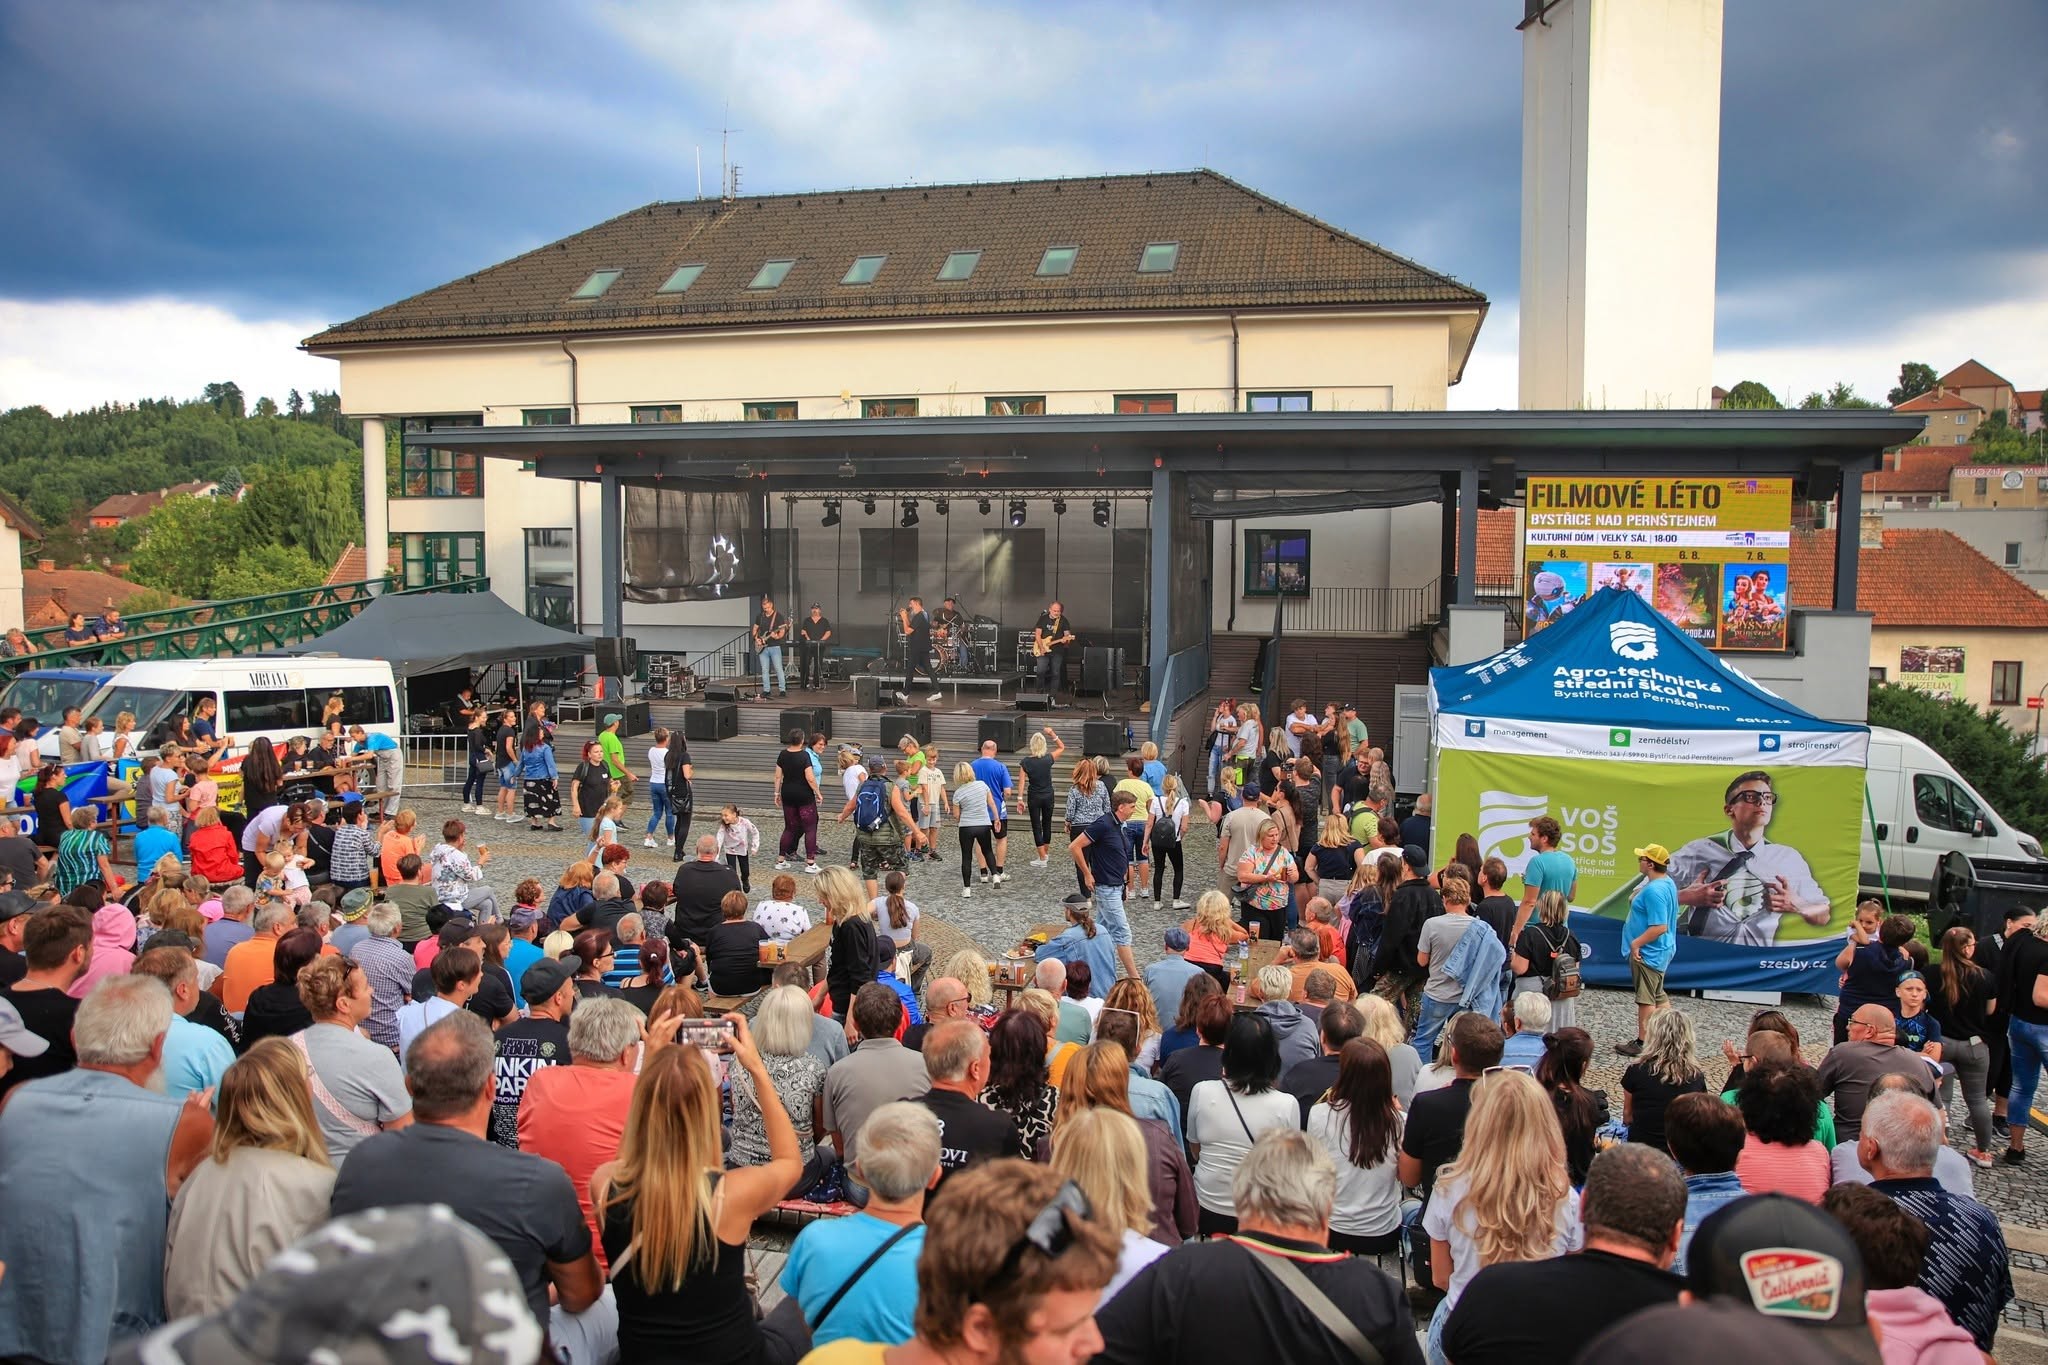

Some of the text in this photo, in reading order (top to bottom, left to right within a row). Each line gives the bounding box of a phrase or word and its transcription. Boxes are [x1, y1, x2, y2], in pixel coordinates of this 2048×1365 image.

[1531, 480, 1720, 509] FILMOVÉ LÉTO
[1531, 512, 1717, 527] BYSTŘICE NAD PERNŠTEJNEM
[1531, 532, 1572, 542] KULTURNÍ
[1574, 532, 1594, 542] DŮM
[1601, 532, 1628, 542] VELKÝ
[1631, 533, 1647, 543] SÁL
[1547, 549, 1568, 558] 4. 8.
[1613, 550, 1633, 559] 5. 8.
[1679, 551, 1700, 560] 6. 8.
[1746, 552, 1766, 560] 7. 8.
[1553, 666, 1722, 693] Agro-technická
[1553, 677, 1699, 700] střední škola
[1553, 690, 1731, 712] Bystřice nad Pernštejnem
[1493, 729, 1548, 739] management
[1638, 736, 1690, 746] zemědělství
[1787, 741, 1841, 751] strojírenství
[1649, 752, 1676, 761] Bystřice
[1560, 805, 1618, 830] VOŠ
[1560, 831, 1617, 855] SOŠ
[1573, 856, 1615, 867] třice nad
[1576, 866, 1615, 876] štejnem
[1759, 958, 1827, 971] szesby.cz
[496, 1057, 557, 1078] INKIN
[496, 1077, 528, 1096] PAR
[940, 1147, 969, 1163] OVI
